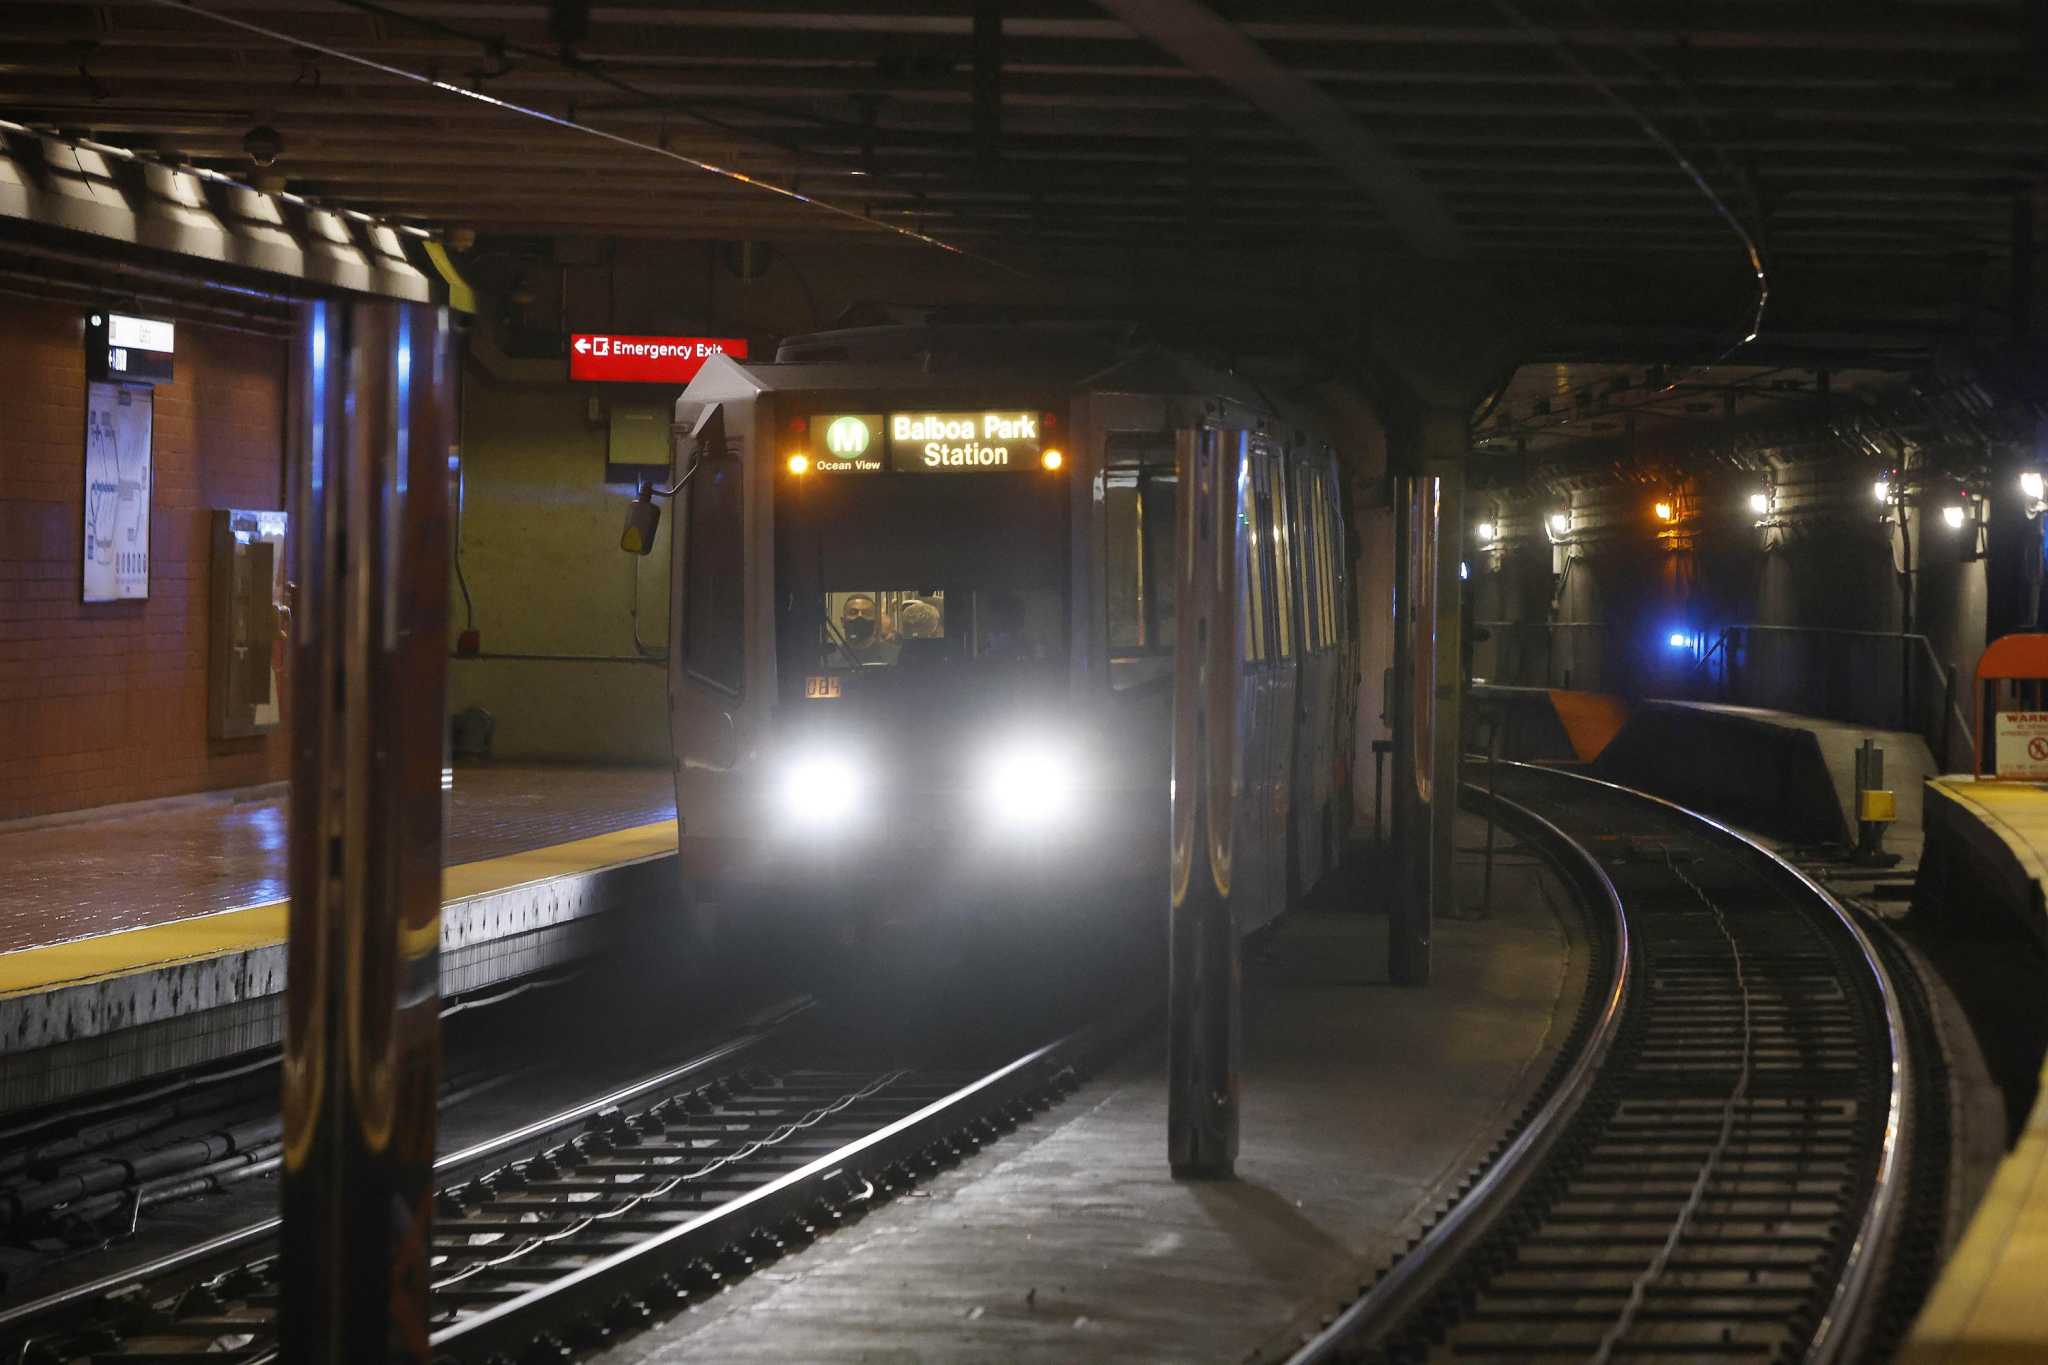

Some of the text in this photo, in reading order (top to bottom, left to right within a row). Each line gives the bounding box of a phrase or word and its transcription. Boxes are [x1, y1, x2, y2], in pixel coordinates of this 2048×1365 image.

[613, 341, 723, 360] Emergency Exit
[832, 421, 864, 452] M
[893, 415, 1037, 441] Balboa Park
[816, 460, 881, 470] Ocean View
[923, 442, 1008, 467] Station
